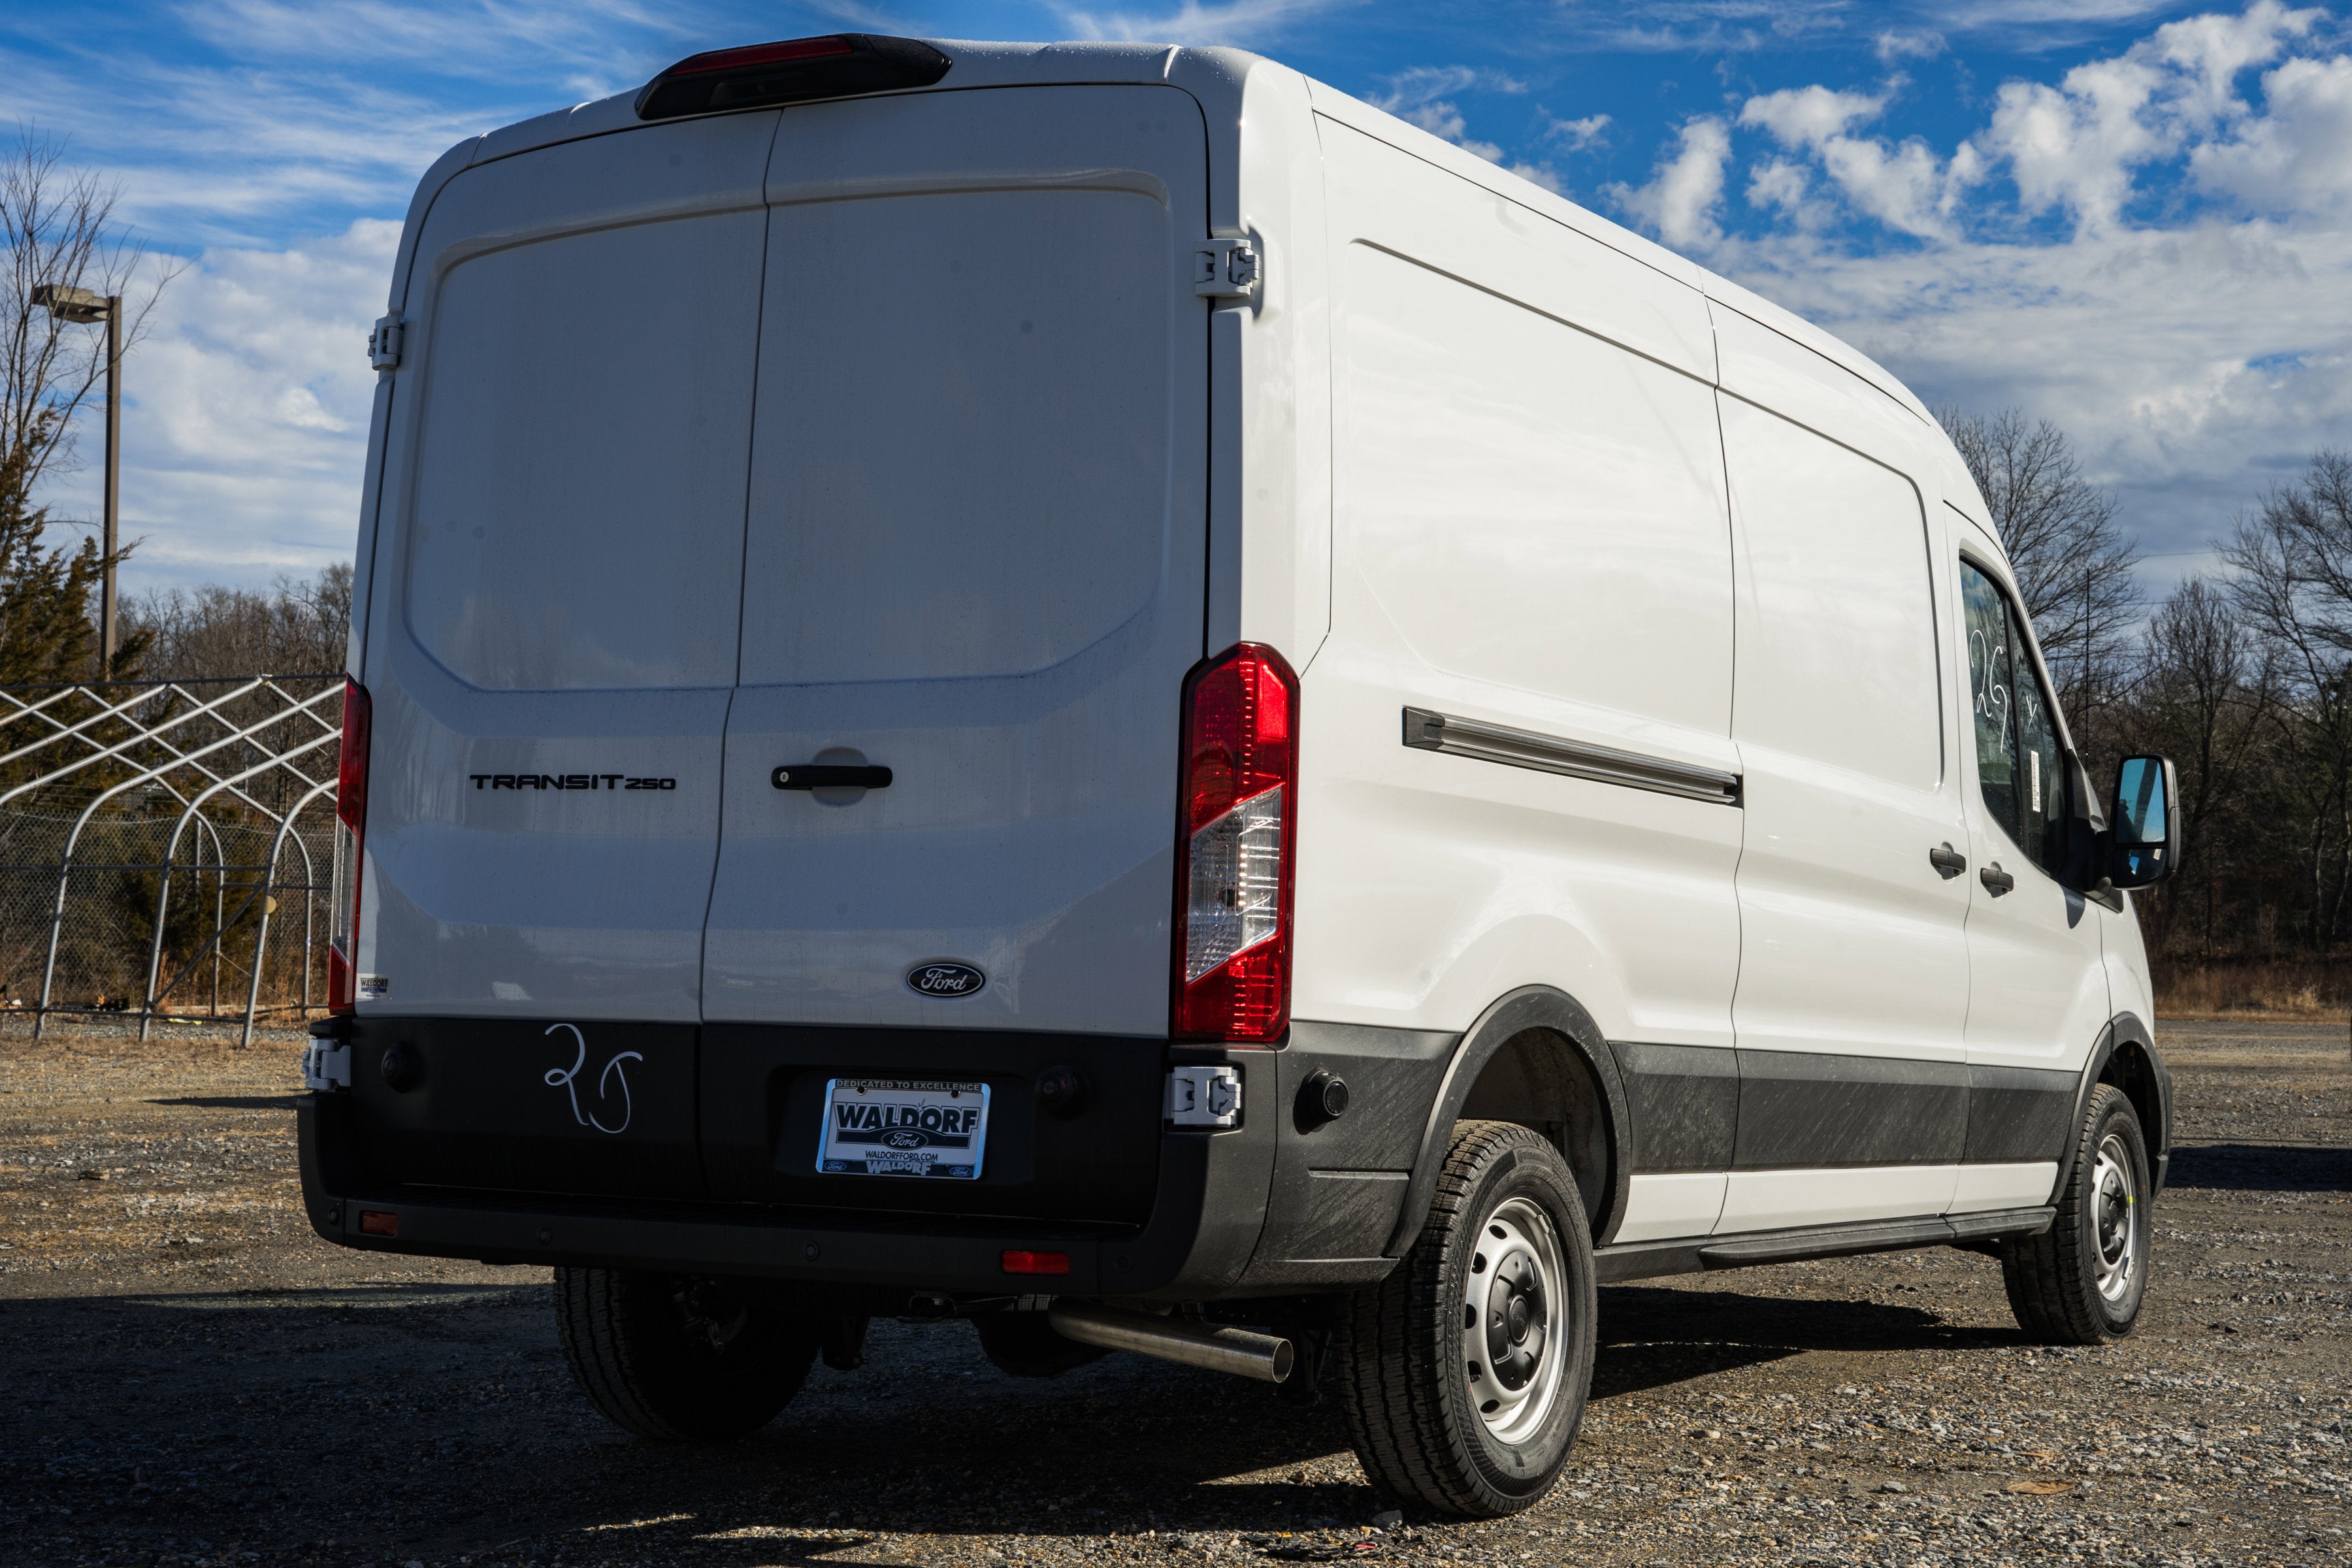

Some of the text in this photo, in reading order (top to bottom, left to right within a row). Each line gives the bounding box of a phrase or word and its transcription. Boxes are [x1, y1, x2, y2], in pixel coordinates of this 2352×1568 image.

[469, 774, 676, 791] TRANSIT 250
[361, 979, 389, 987] WALDORF
[921, 968, 968, 990] Ford
[836, 1080, 893, 1088] DEDICATED
[913, 1081, 980, 1091] EXCELLENCE
[835, 1103, 979, 1134] WALDORF
[889, 1132, 919, 1147] Ford
[865, 1151, 938, 1162] WALDORFFORD.COM
[866, 1160, 932, 1176] WALDORF
